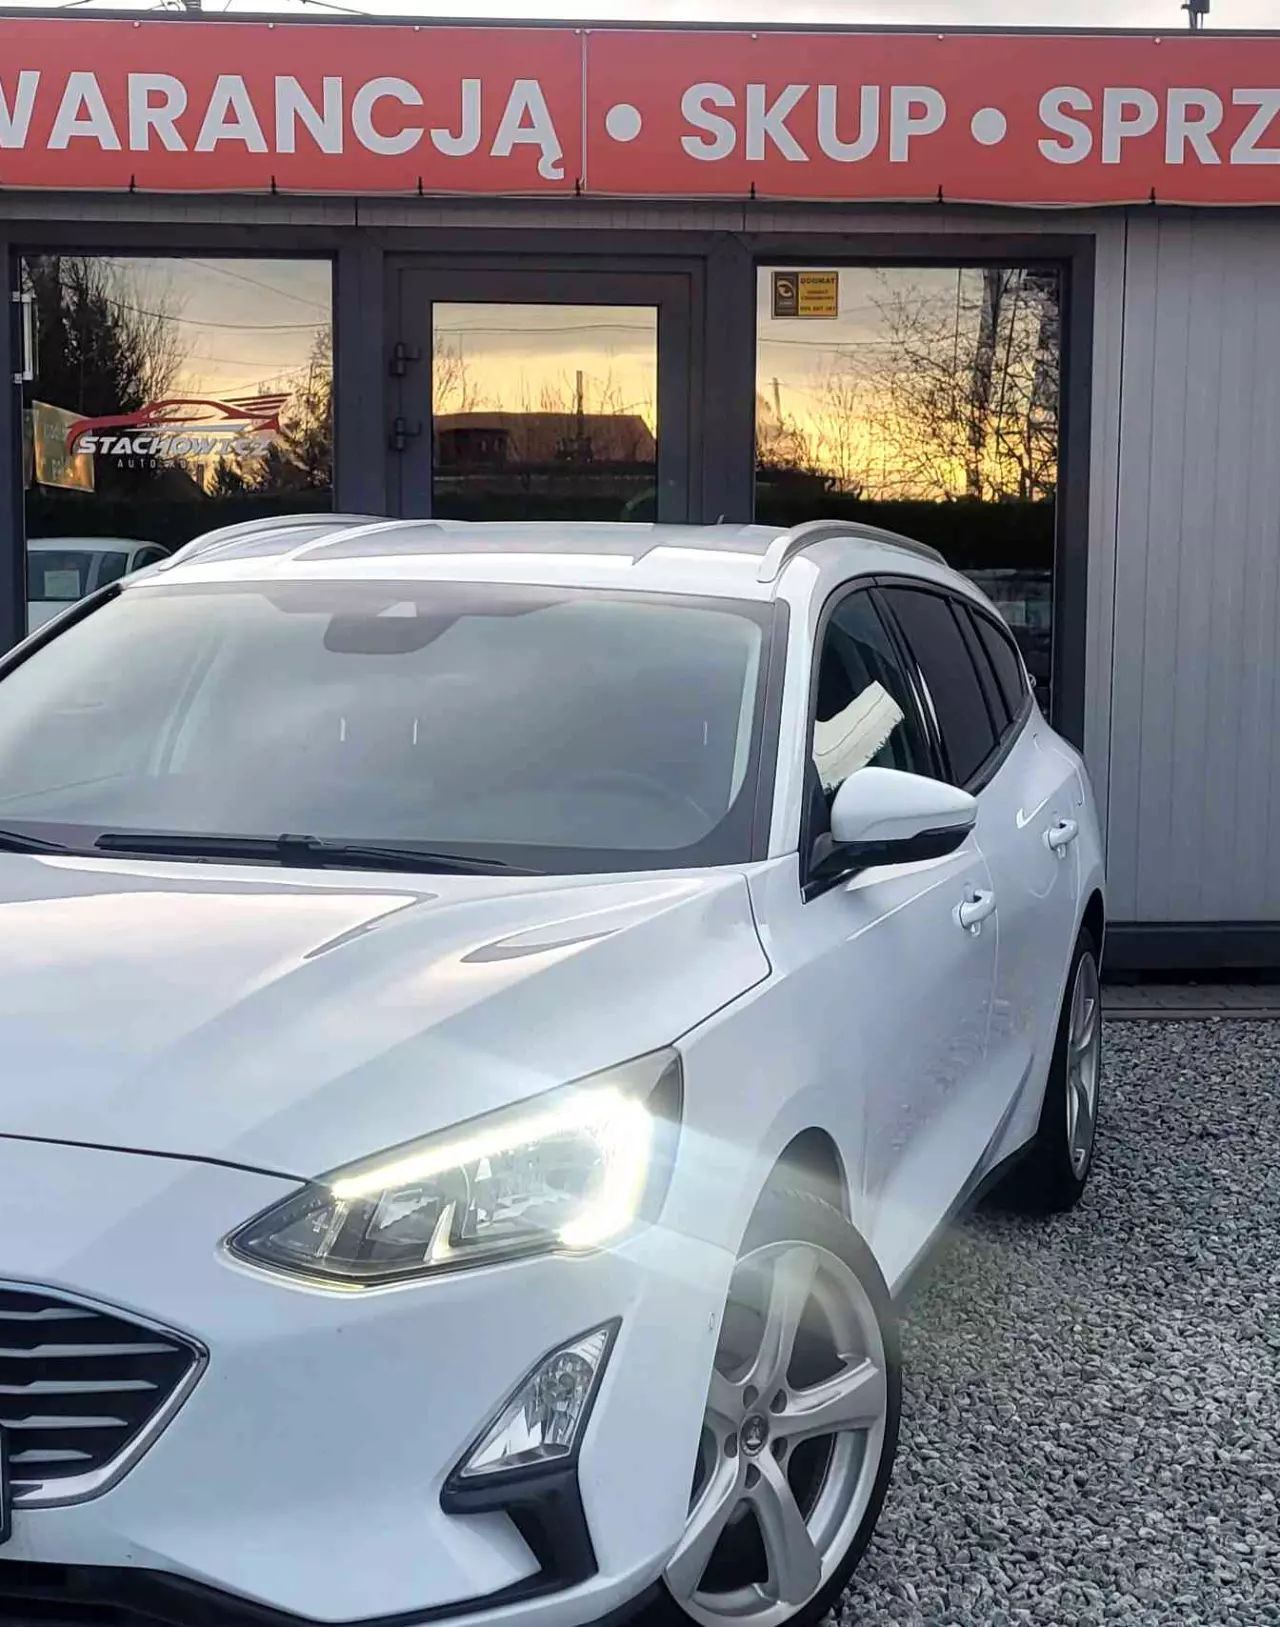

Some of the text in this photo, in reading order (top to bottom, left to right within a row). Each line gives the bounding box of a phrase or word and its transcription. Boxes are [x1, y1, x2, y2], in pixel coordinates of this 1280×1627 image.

[681, 83, 946, 163] SKUP
[76, 436, 272, 456] STACHOWICZ
[117, 458, 157, 469] AUTO
